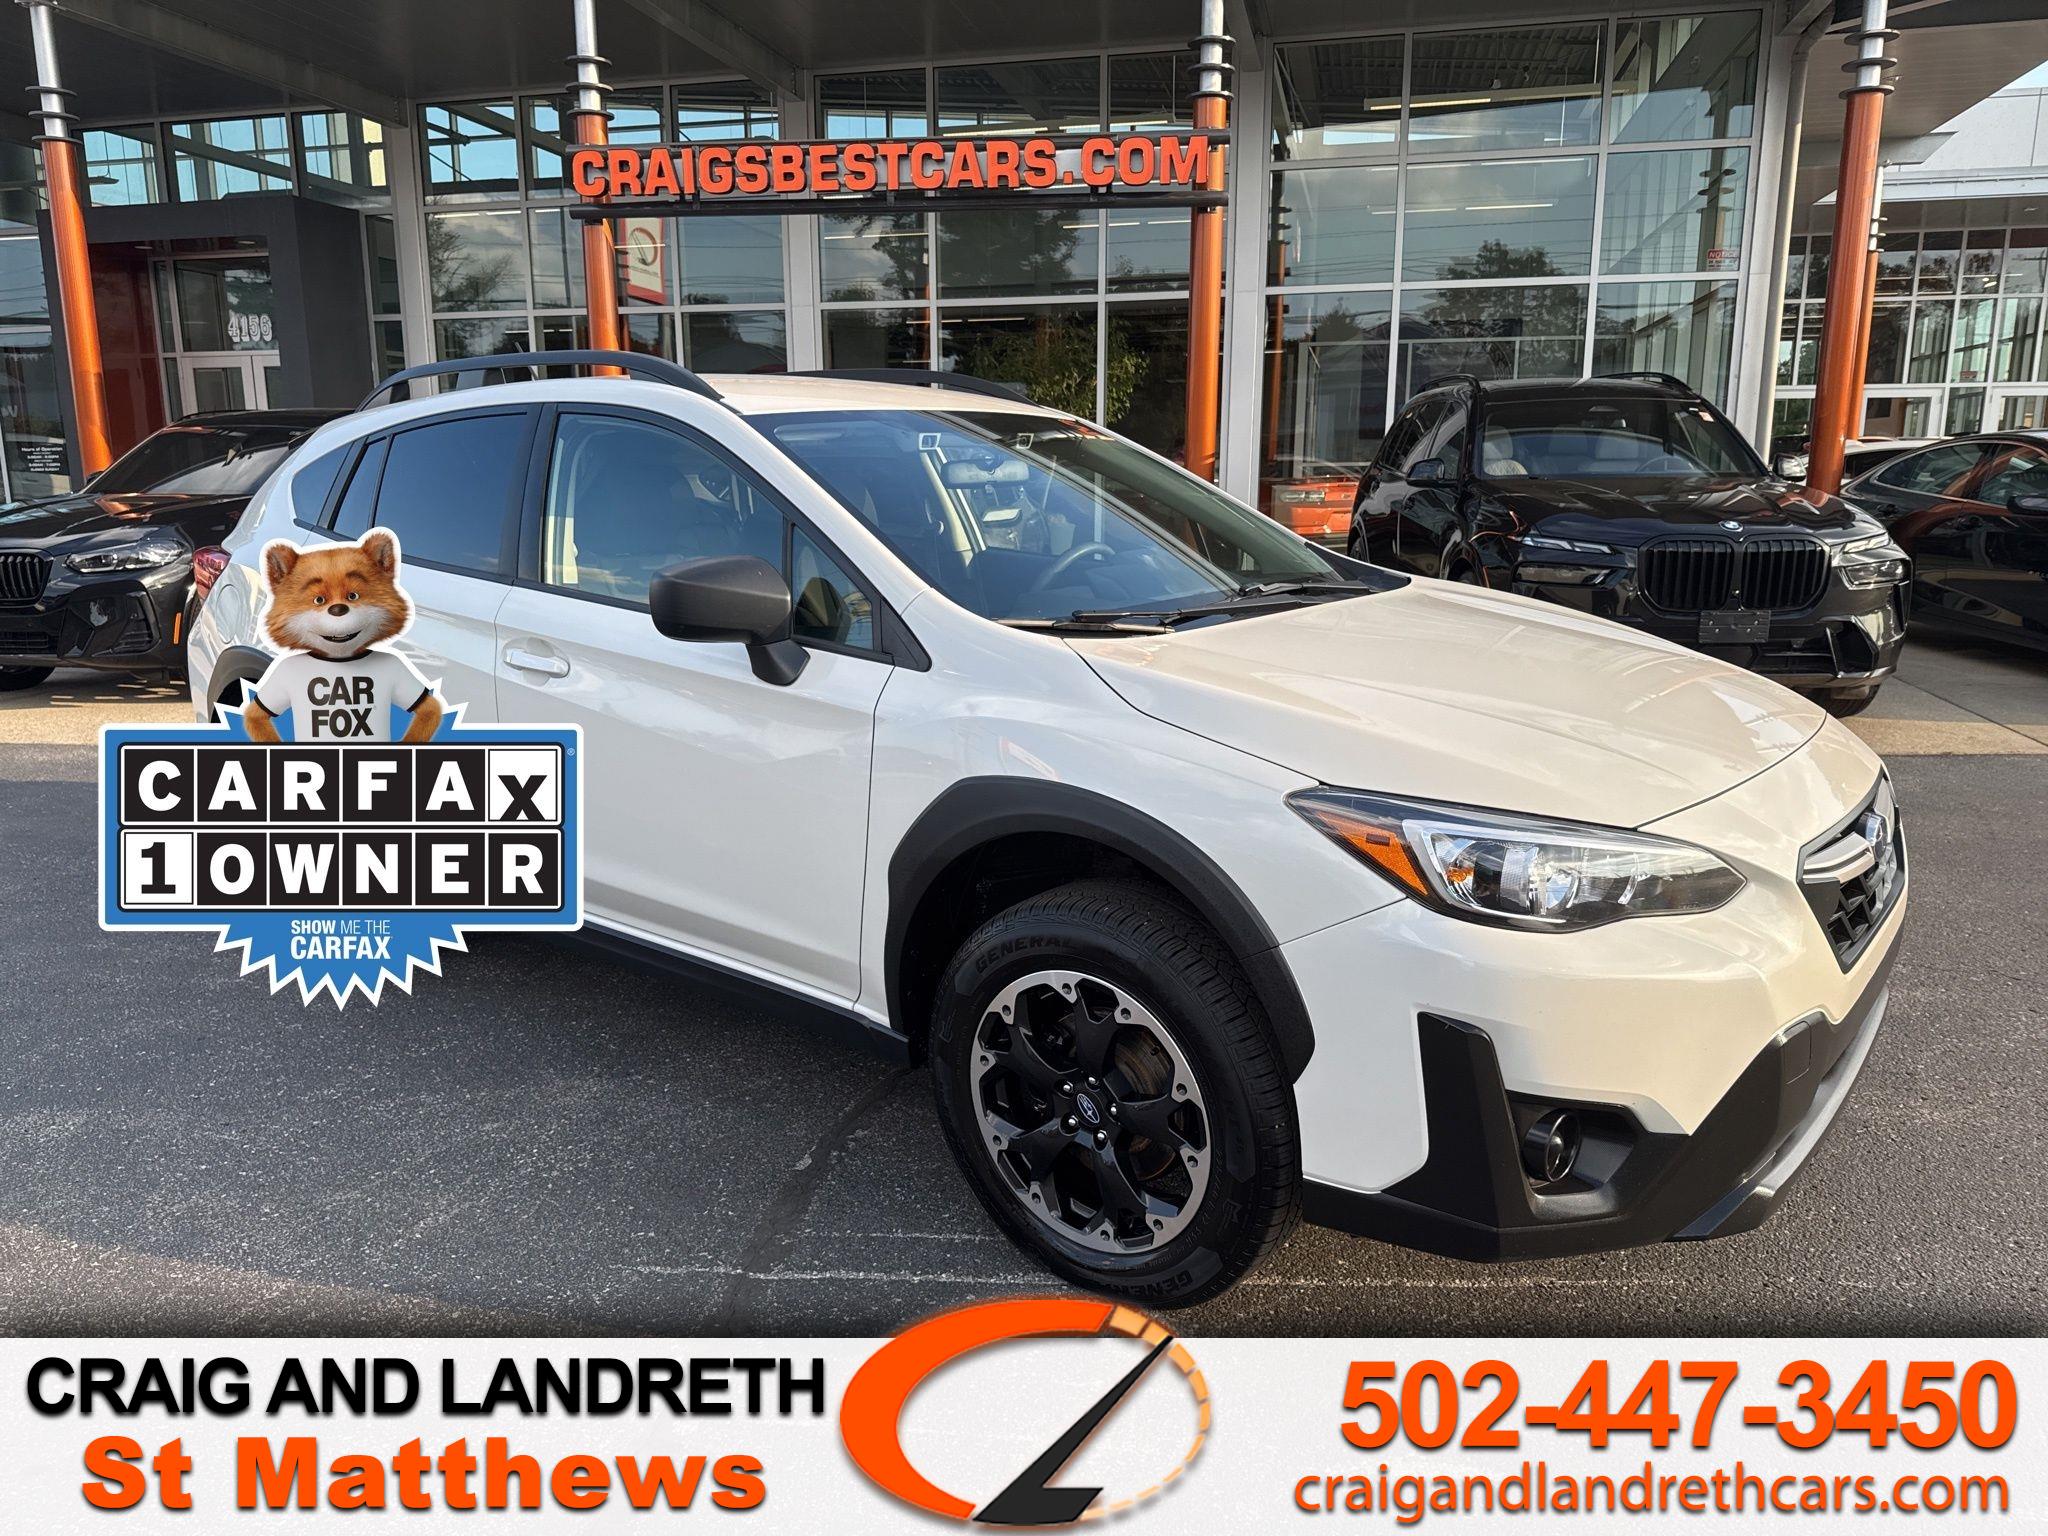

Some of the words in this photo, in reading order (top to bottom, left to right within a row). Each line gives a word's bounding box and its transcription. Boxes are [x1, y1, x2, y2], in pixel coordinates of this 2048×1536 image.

[572, 135, 1210, 196] CRAIGSBESTCARS.COM
[228, 313, 272, 342] 4156
[975, 935, 1077, 974] GENERAL
